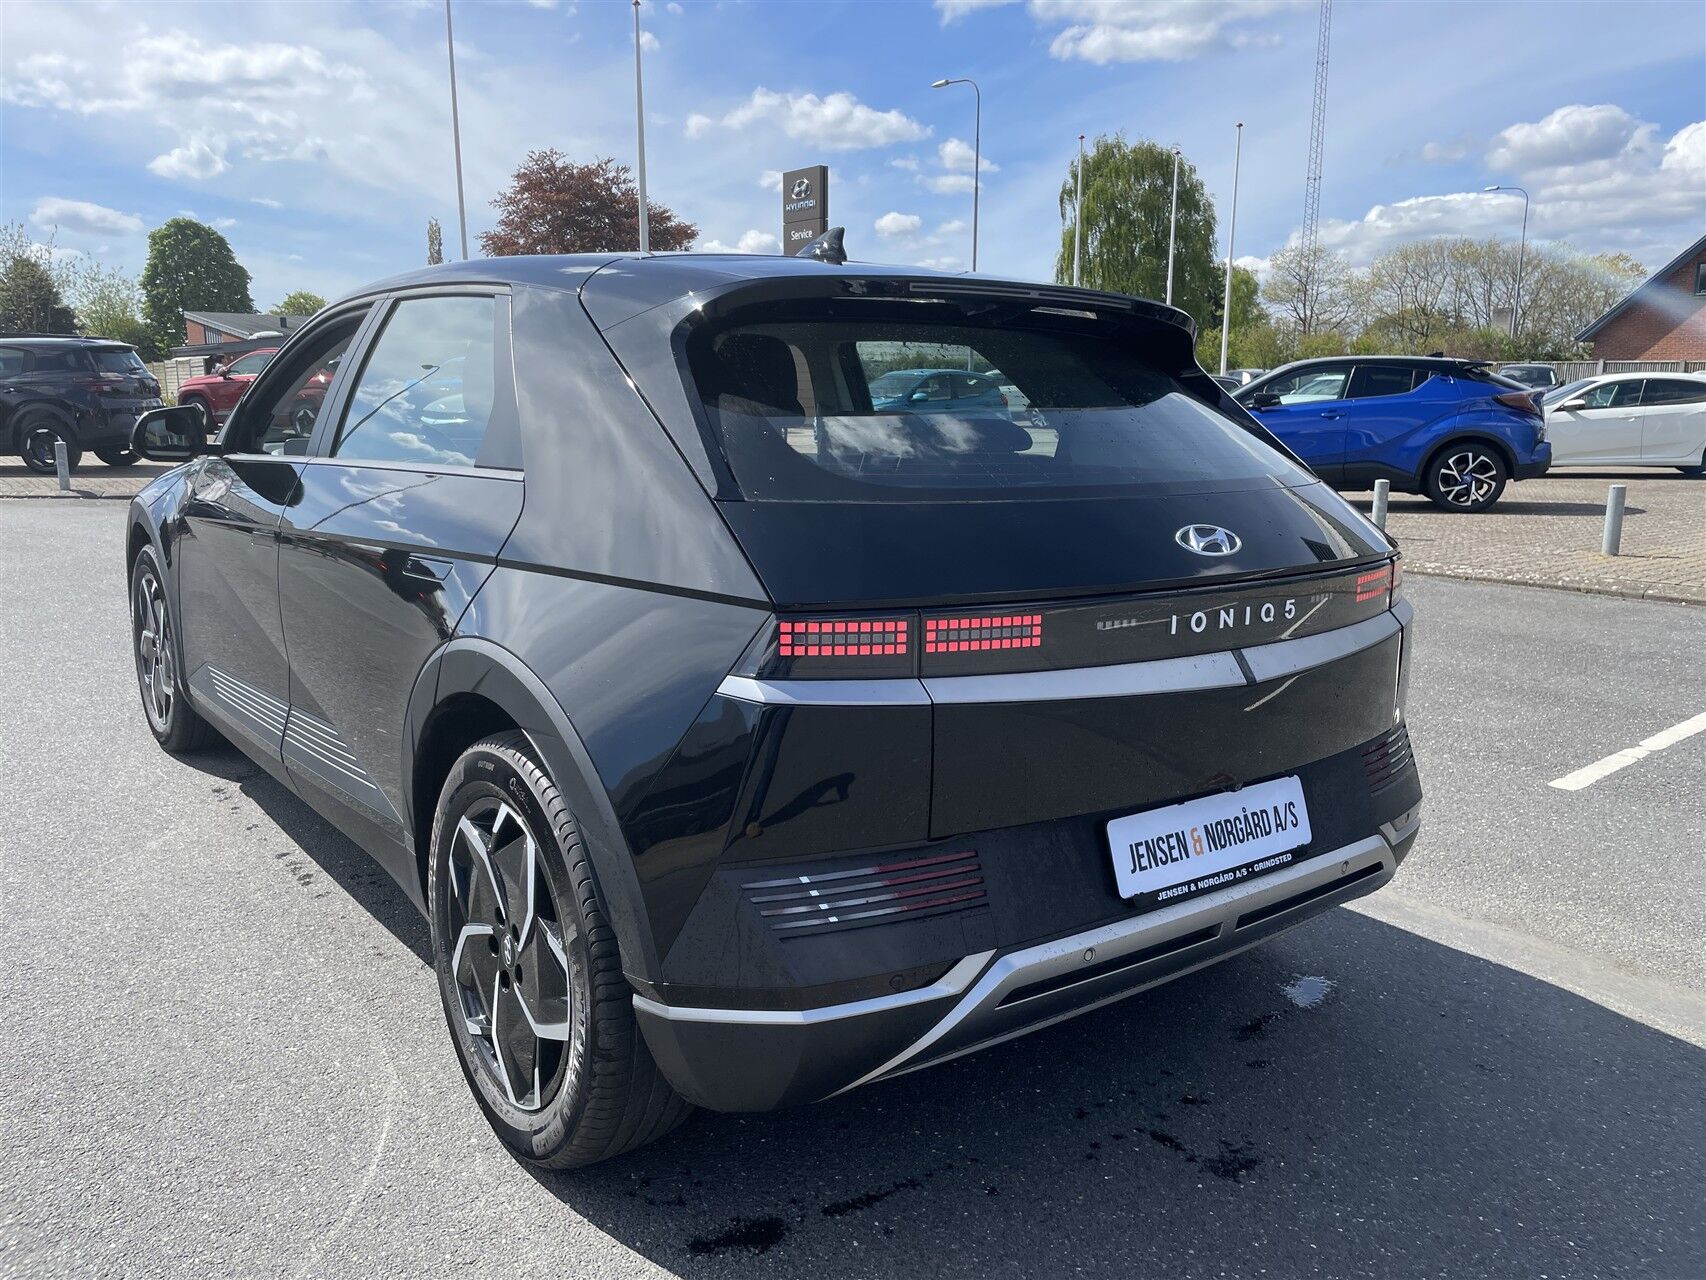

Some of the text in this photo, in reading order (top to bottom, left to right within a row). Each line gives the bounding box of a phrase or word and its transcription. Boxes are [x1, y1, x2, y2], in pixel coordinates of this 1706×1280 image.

[791, 229, 813, 241] Service
[1129, 801, 1299, 875] JENSEN & NØRGÅRD A/S
[1157, 853, 1292, 901] JENSEN & NØRGÅRD A/S GRINDSTED
